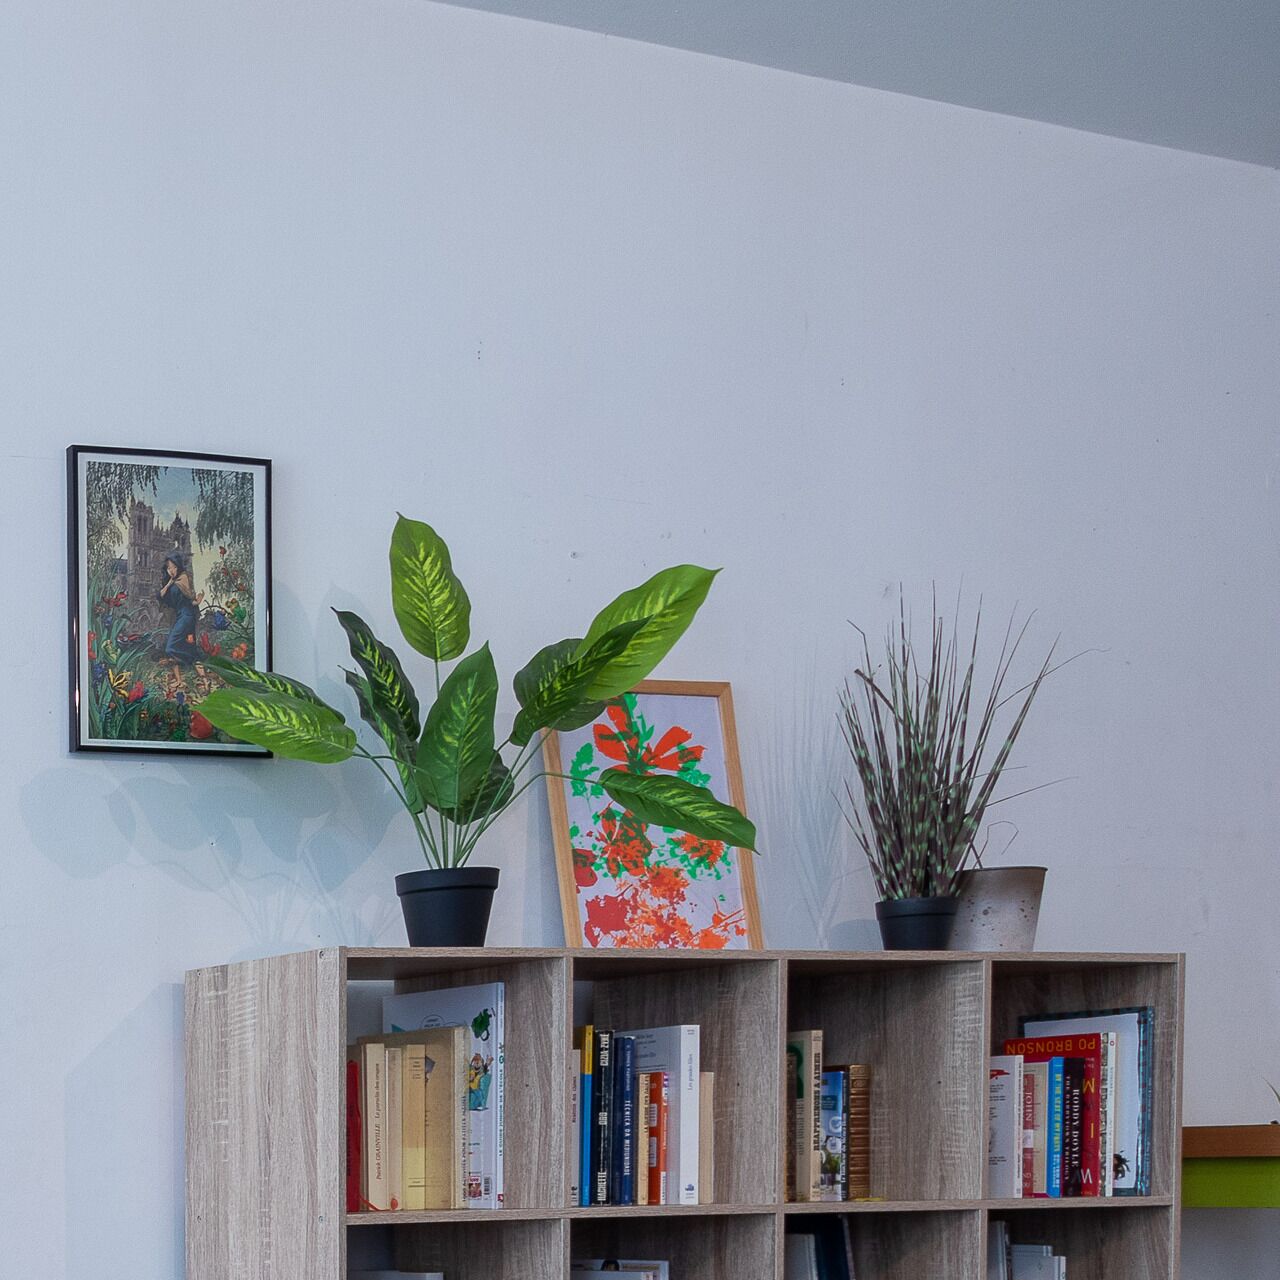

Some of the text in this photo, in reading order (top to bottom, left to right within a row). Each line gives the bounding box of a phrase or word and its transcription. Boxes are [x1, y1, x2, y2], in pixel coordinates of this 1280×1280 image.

[1006, 1037, 1096, 1055] PO BRONSON
[1025, 1091, 1033, 1121] JOHN
[1072, 1089, 1080, 1167] RODDY DOYLE
[597, 1172, 607, 1201] HACHETTE
